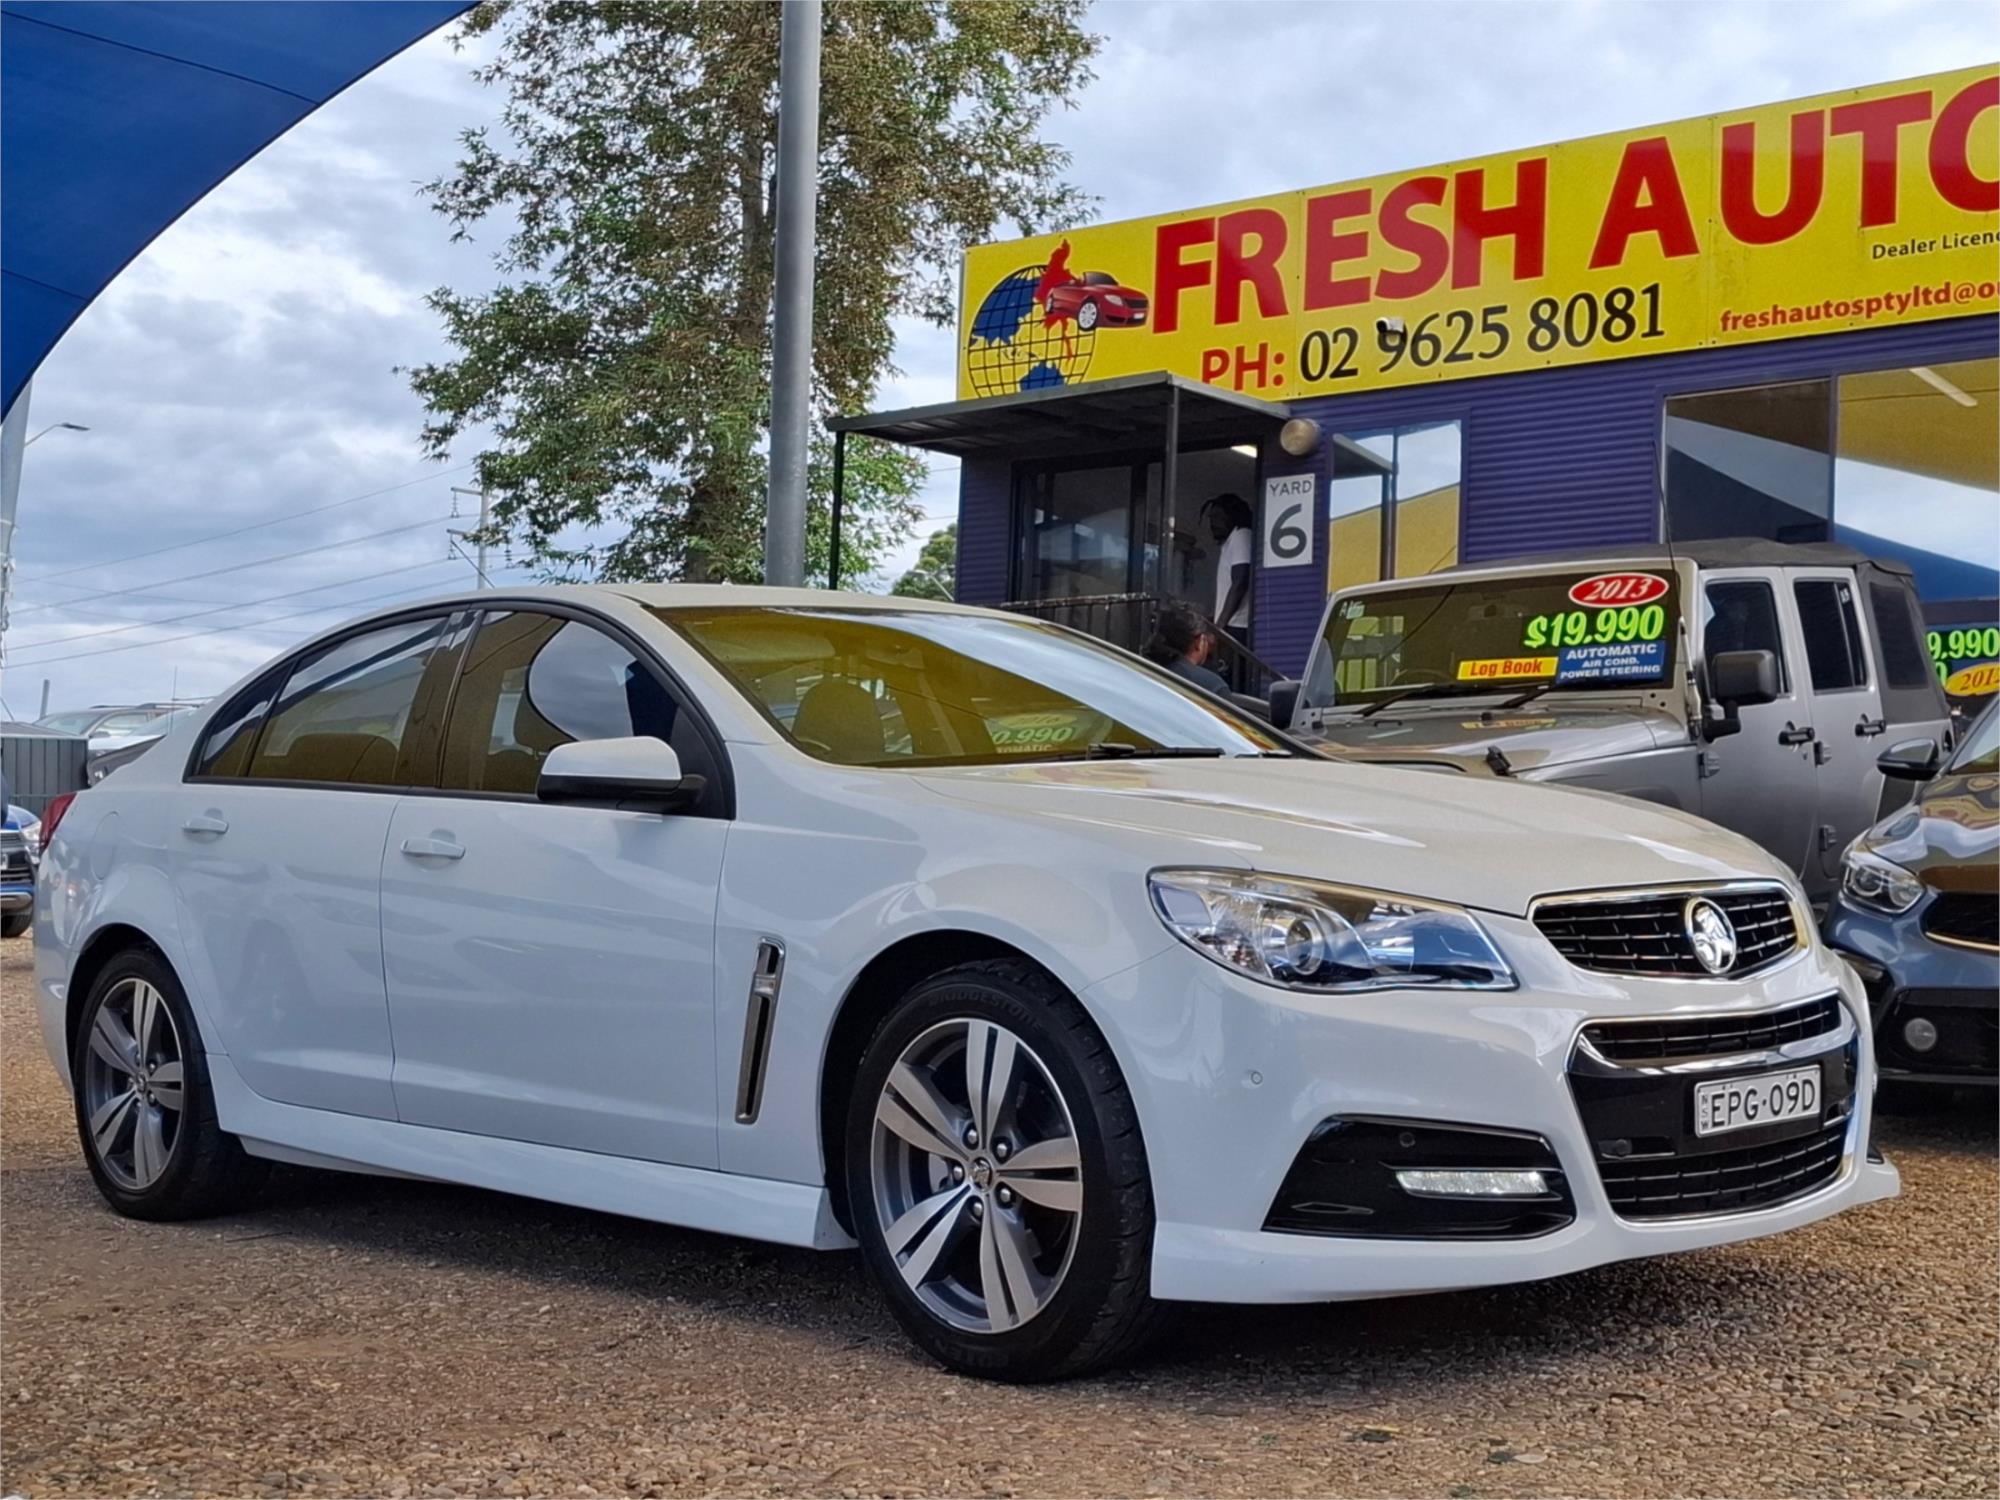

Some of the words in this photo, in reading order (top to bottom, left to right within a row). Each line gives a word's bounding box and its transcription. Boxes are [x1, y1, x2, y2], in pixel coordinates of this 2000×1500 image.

[1153, 157, 1548, 333] FRESH
[1873, 239, 1936, 259] Dealer
[1721, 282, 1999, 331] freshautosptyltd@o
[1202, 342, 1284, 391] PH:
[1301, 327, 1358, 382] 02
[1377, 305, 1509, 373] 9625
[1527, 282, 1665, 352] 8081
[1269, 480, 1312, 497] YARD
[1270, 503, 1307, 559] 6
[1584, 579, 1652, 600] 2013
[1566, 644, 1657, 660] AUTOMATIC
[1470, 661, 1498, 677] Log
[1502, 659, 1543, 675] Book
[1560, 668, 1599, 679] POWER
[1602, 665, 1660, 676] STEERING
[1582, 660, 1601, 668] AIR
[1604, 657, 1640, 667] COND.
